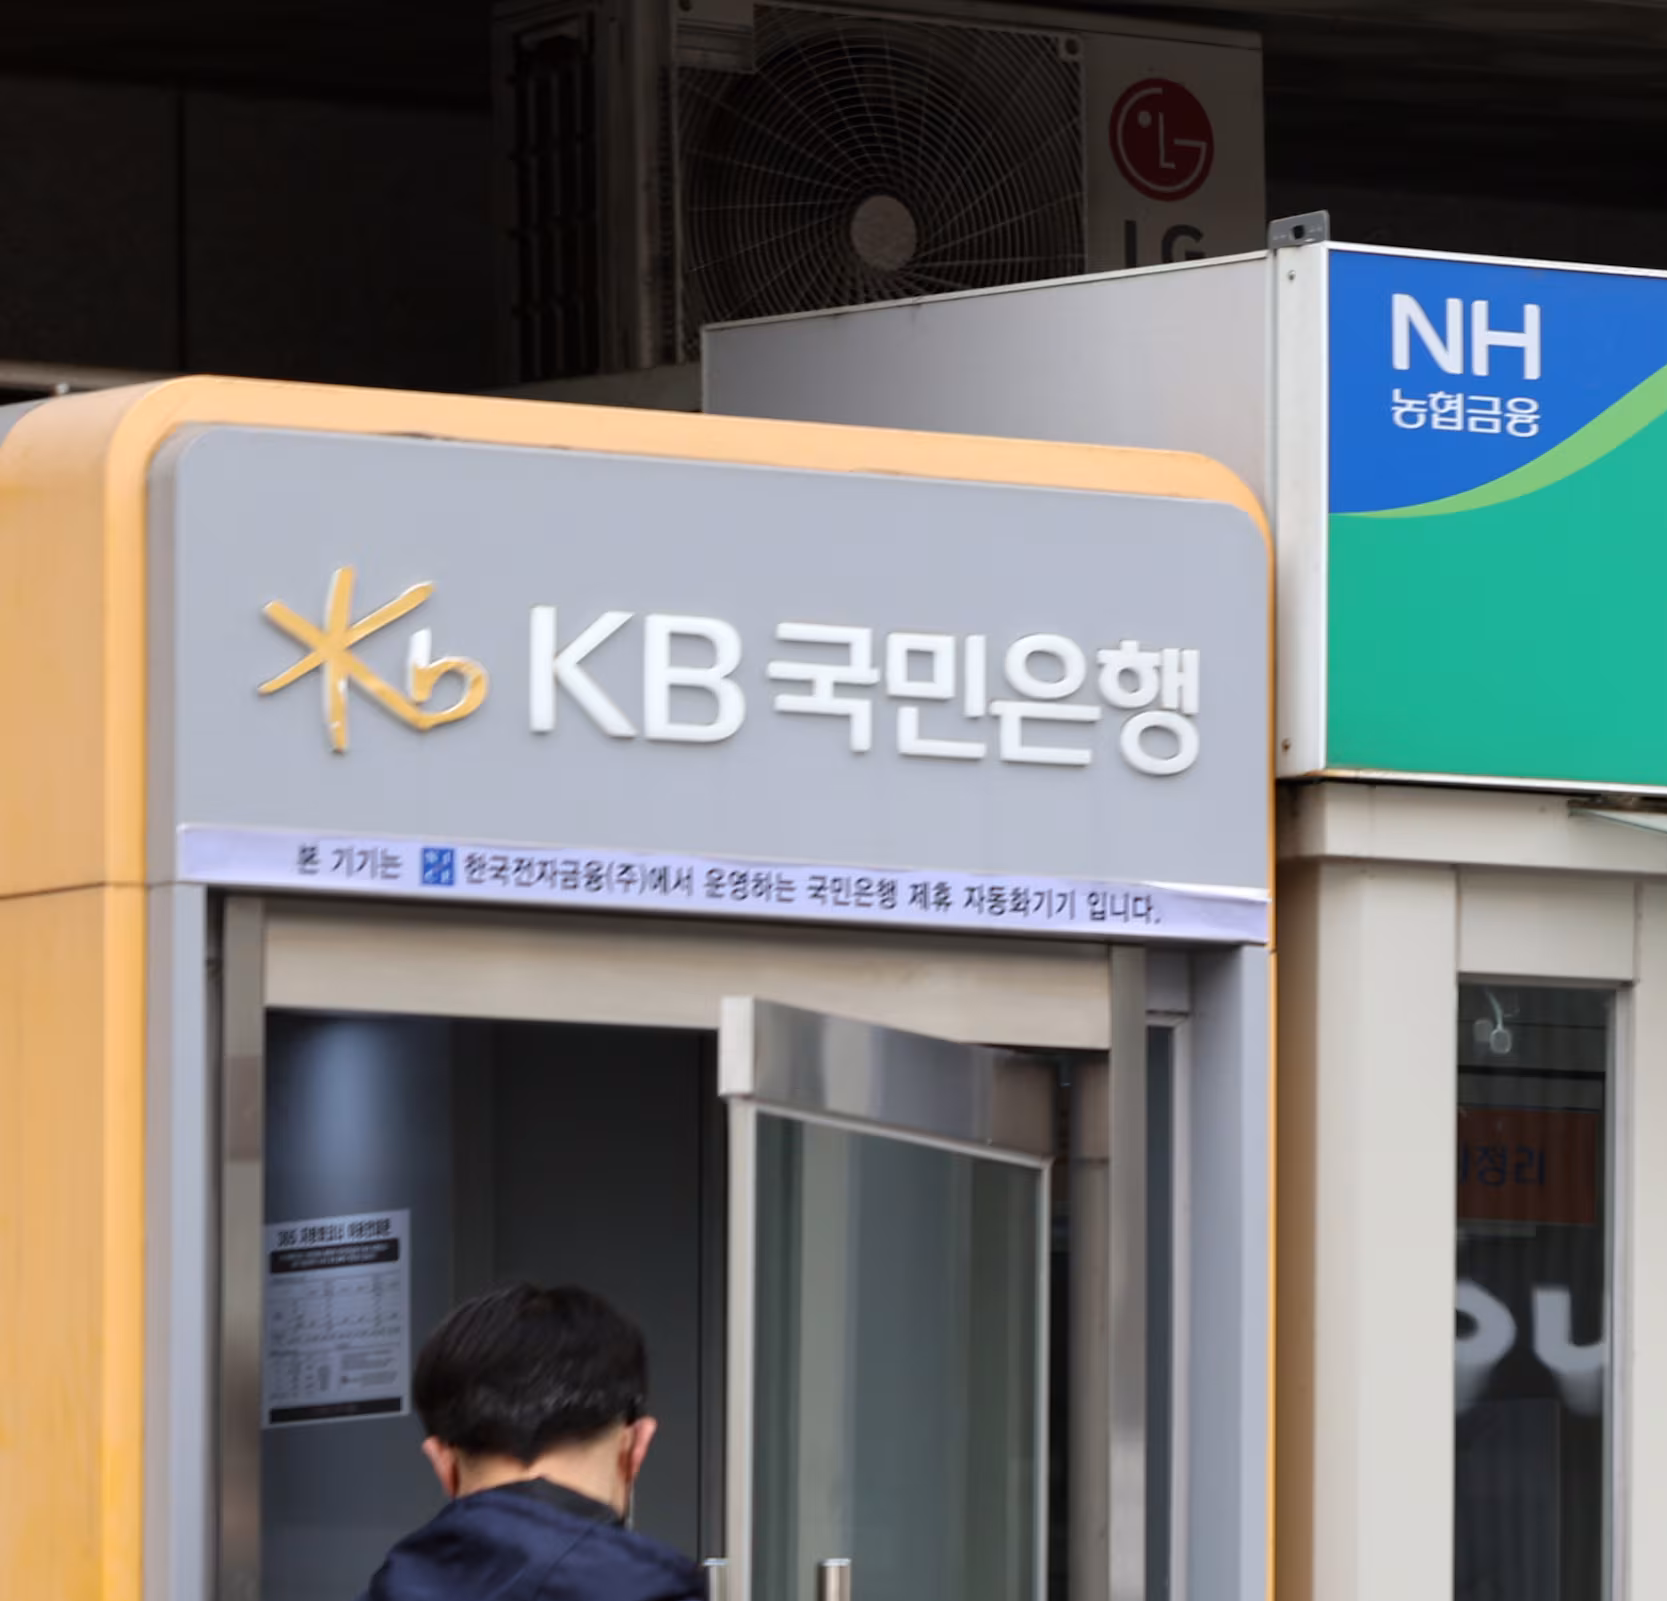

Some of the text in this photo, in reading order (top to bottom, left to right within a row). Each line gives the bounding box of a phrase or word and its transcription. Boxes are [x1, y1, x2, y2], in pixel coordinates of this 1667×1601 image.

[1391, 293, 1541, 380] NH
[1391, 388, 1541, 438] 농협금융
[332, 845, 402, 881] 기기는
[704, 866, 795, 903] 운영하는
[807, 873, 898, 909] 국민은행
[908, 880, 952, 911] 제휴
[963, 884, 1078, 920] 자동화기기
